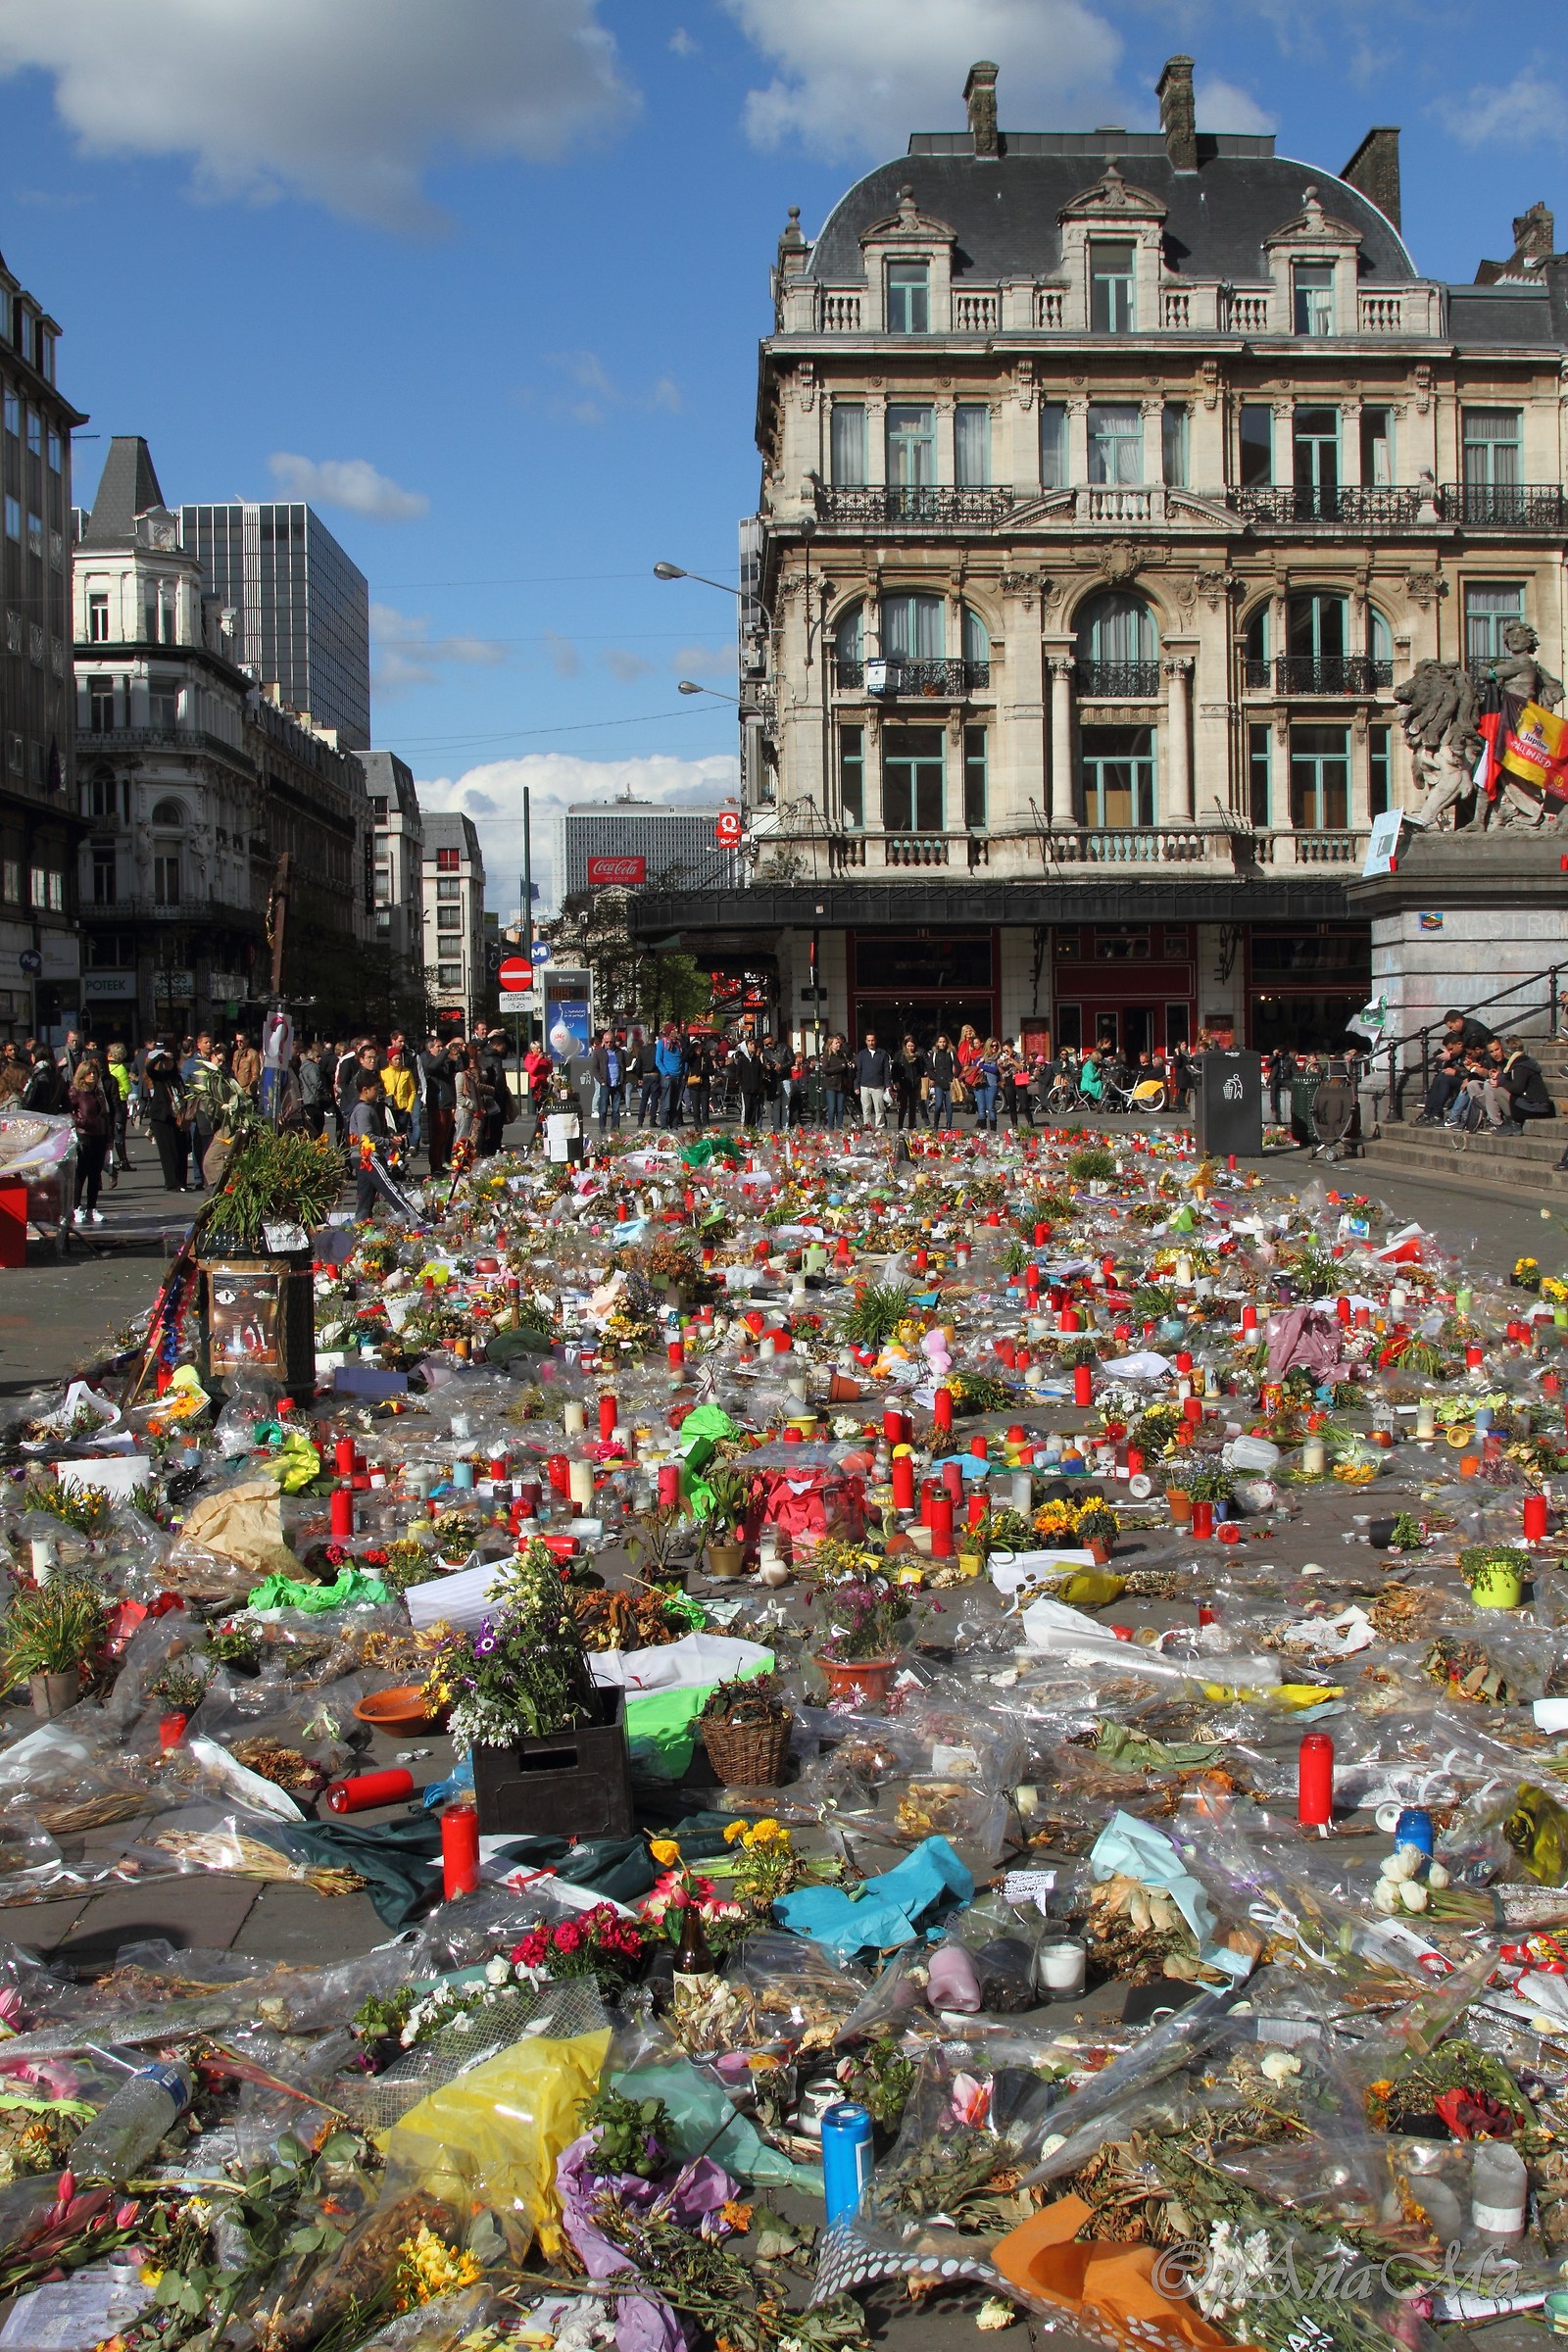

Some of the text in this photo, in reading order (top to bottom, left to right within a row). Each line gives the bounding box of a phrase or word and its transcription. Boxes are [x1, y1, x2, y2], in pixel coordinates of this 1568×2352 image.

[1522, 732, 1548, 752] Jupiler
[721, 815, 738, 833] Q
[86, 980, 125, 991] POTEEK
